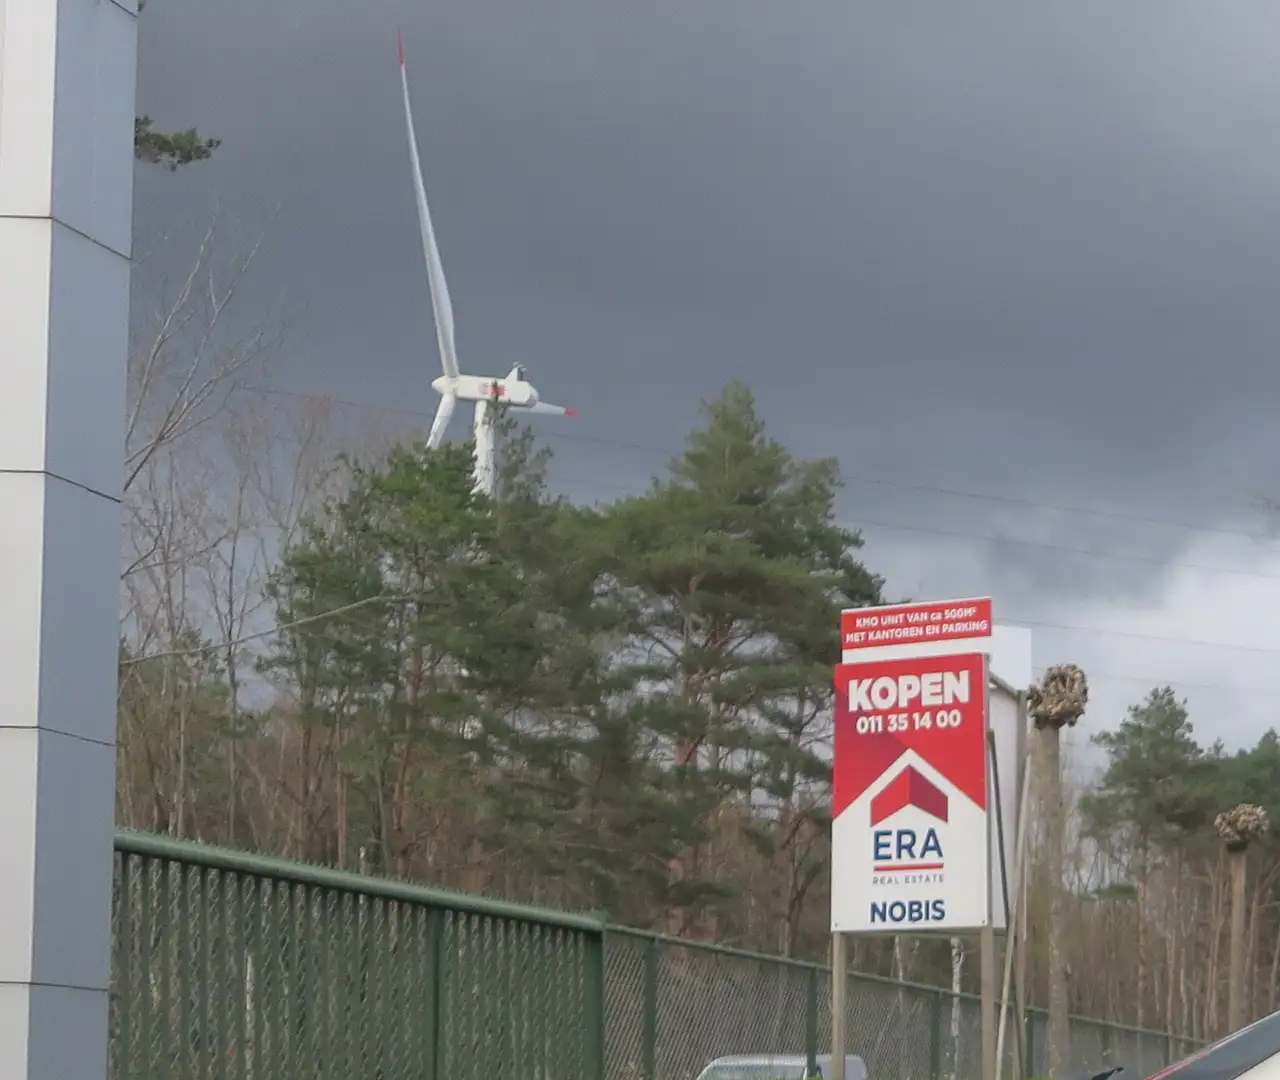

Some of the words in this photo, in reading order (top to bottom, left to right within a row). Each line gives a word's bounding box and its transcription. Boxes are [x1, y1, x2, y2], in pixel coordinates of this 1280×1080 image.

[906, 611, 929, 623] VAN
[846, 631, 866, 643] MET
[868, 626, 924, 642] KANTOREN
[925, 624, 940, 636] EN
[942, 620, 988, 633] PARKING
[849, 670, 970, 712] KOPEN
[856, 715, 883, 735] 011
[887, 713, 909, 733] 35
[912, 711, 932, 730] 14
[936, 709, 962, 728] 00
[873, 827, 943, 861] ERA
[872, 875, 900, 886] REAL
[904, 873, 944, 884] ESTATE
[870, 899, 946, 923] NOBIS
